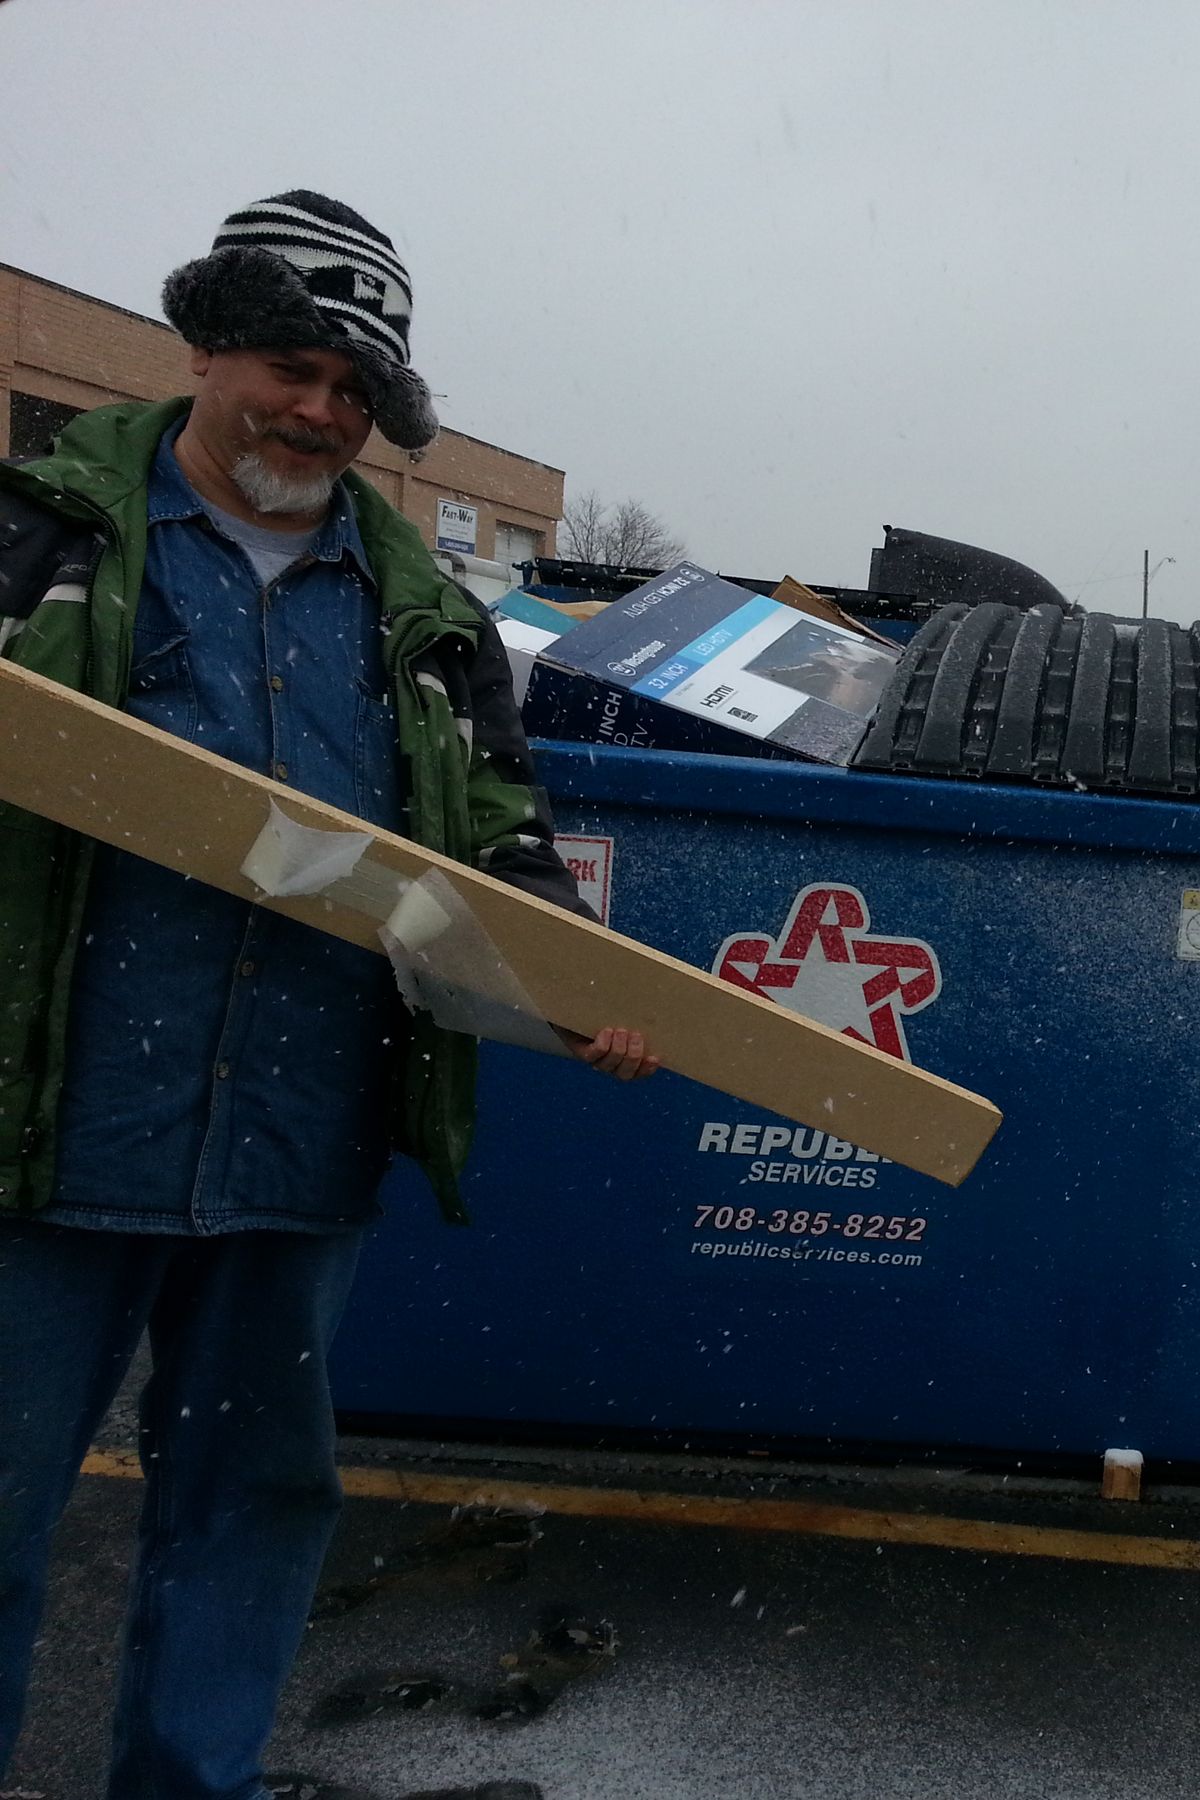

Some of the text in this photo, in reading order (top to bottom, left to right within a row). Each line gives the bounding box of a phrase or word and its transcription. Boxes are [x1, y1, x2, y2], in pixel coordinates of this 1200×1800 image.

[648, 678, 669, 690] 32
[661, 662, 688, 681] INCH
[598, 691, 622, 737] INCH
[631, 723, 648, 746] TV
[567, 858, 597, 882] RK
[698, 1122, 893, 1164] REPUB
[748, 1161, 877, 1189] SERVICES
[693, 1205, 927, 1241] 708-385-8252
